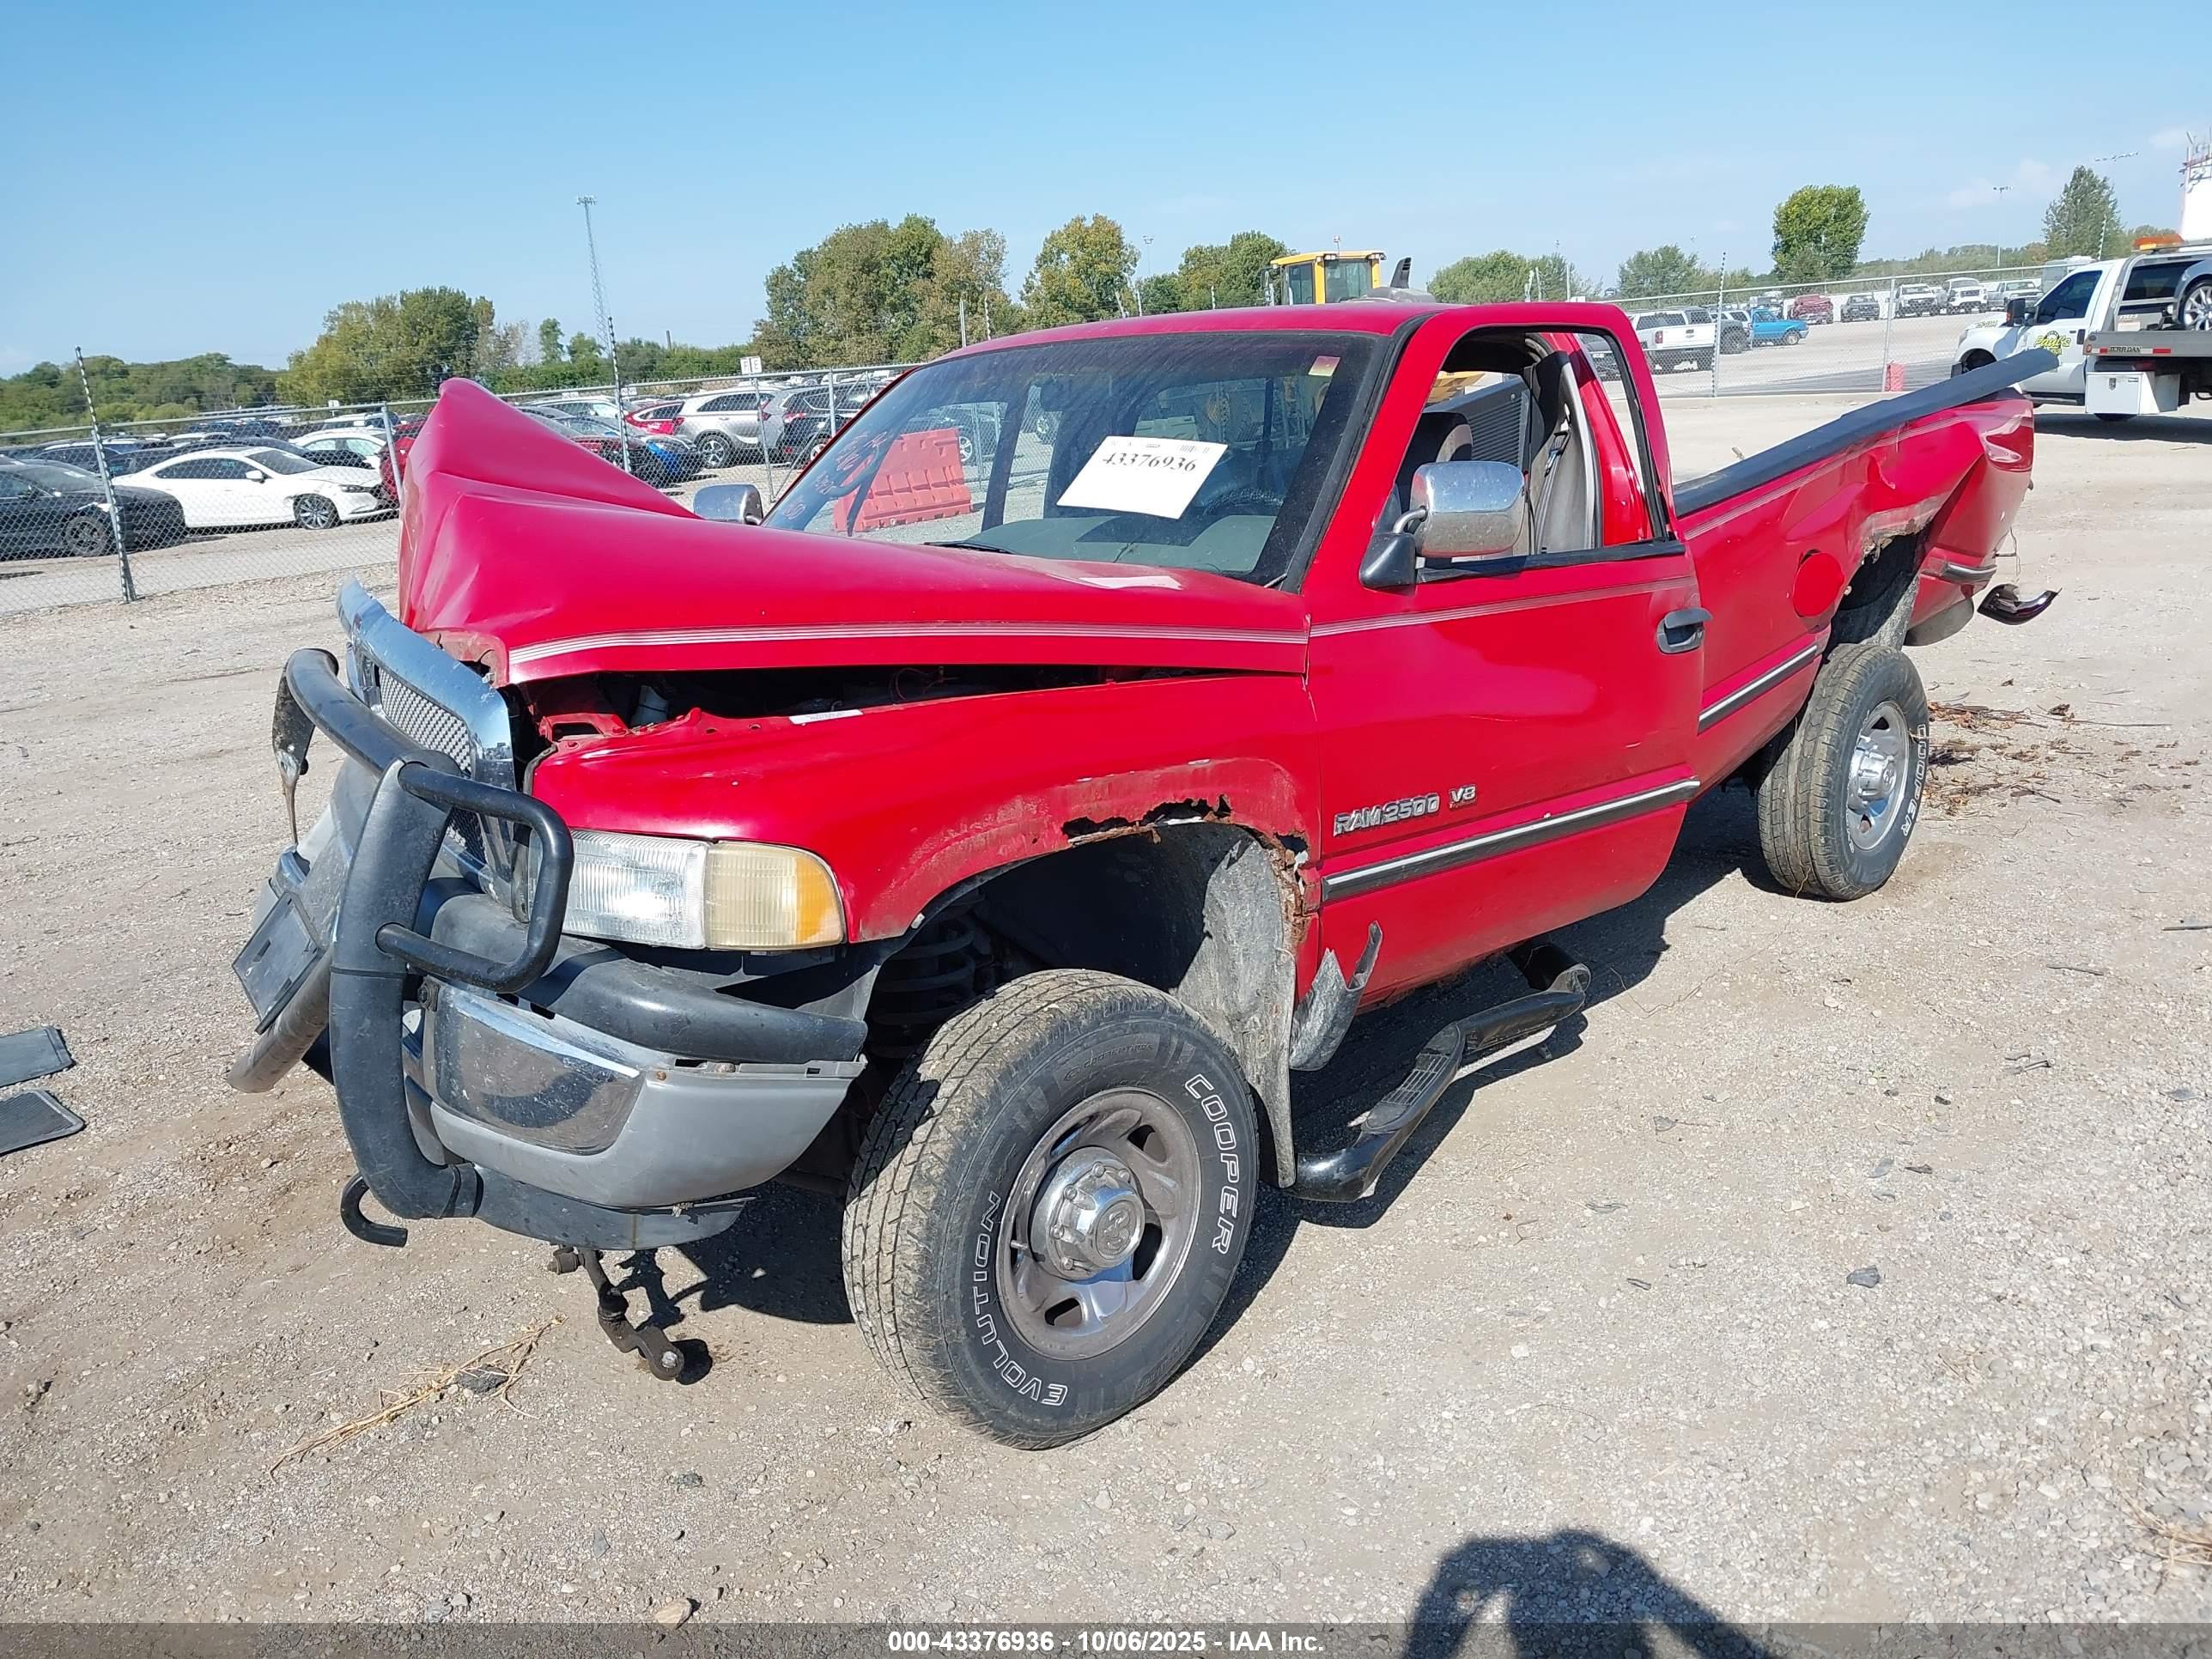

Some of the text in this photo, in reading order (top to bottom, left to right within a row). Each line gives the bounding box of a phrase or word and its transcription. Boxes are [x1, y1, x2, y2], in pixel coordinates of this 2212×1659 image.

[1103, 453, 1196, 471] 43376936
[1382, 793, 1440, 823] 2500
[1449, 784, 1476, 802] V8
[1900, 724, 1927, 837] COOPER
[1185, 1073, 1240, 1255] COOPER
[973, 1191, 1068, 1406] EVOLUTION
